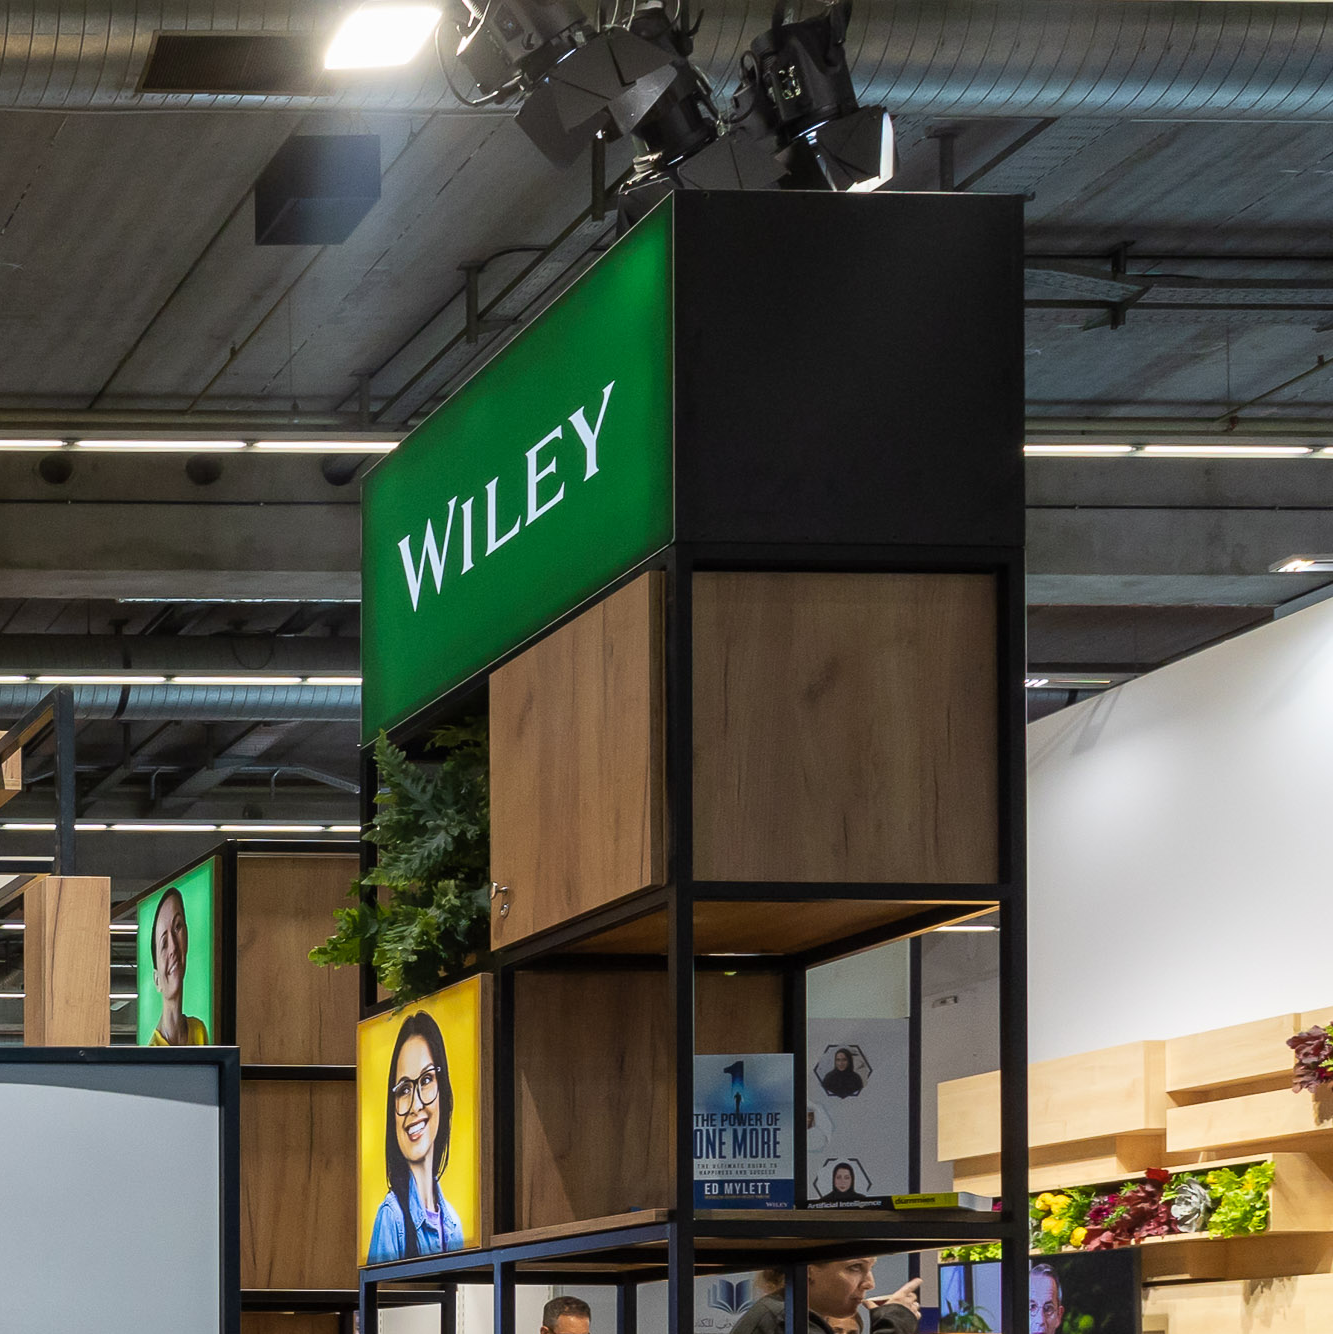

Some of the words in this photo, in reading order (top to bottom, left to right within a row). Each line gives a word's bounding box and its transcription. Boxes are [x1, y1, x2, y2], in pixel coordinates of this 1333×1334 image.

[397, 380, 615, 613] WILEY
[694, 1113, 717, 1127] THE
[721, 1112, 763, 1127] POWER
[766, 1112, 781, 1126] OF
[693, 1128, 727, 1160] ONE
[732, 1127, 781, 1159] MORE
[704, 1182, 719, 1195] ED
[724, 1182, 771, 1195] MYLETT
[807, 1201, 838, 1210] Artificial
[839, 1200, 882, 1209] Intelligence
